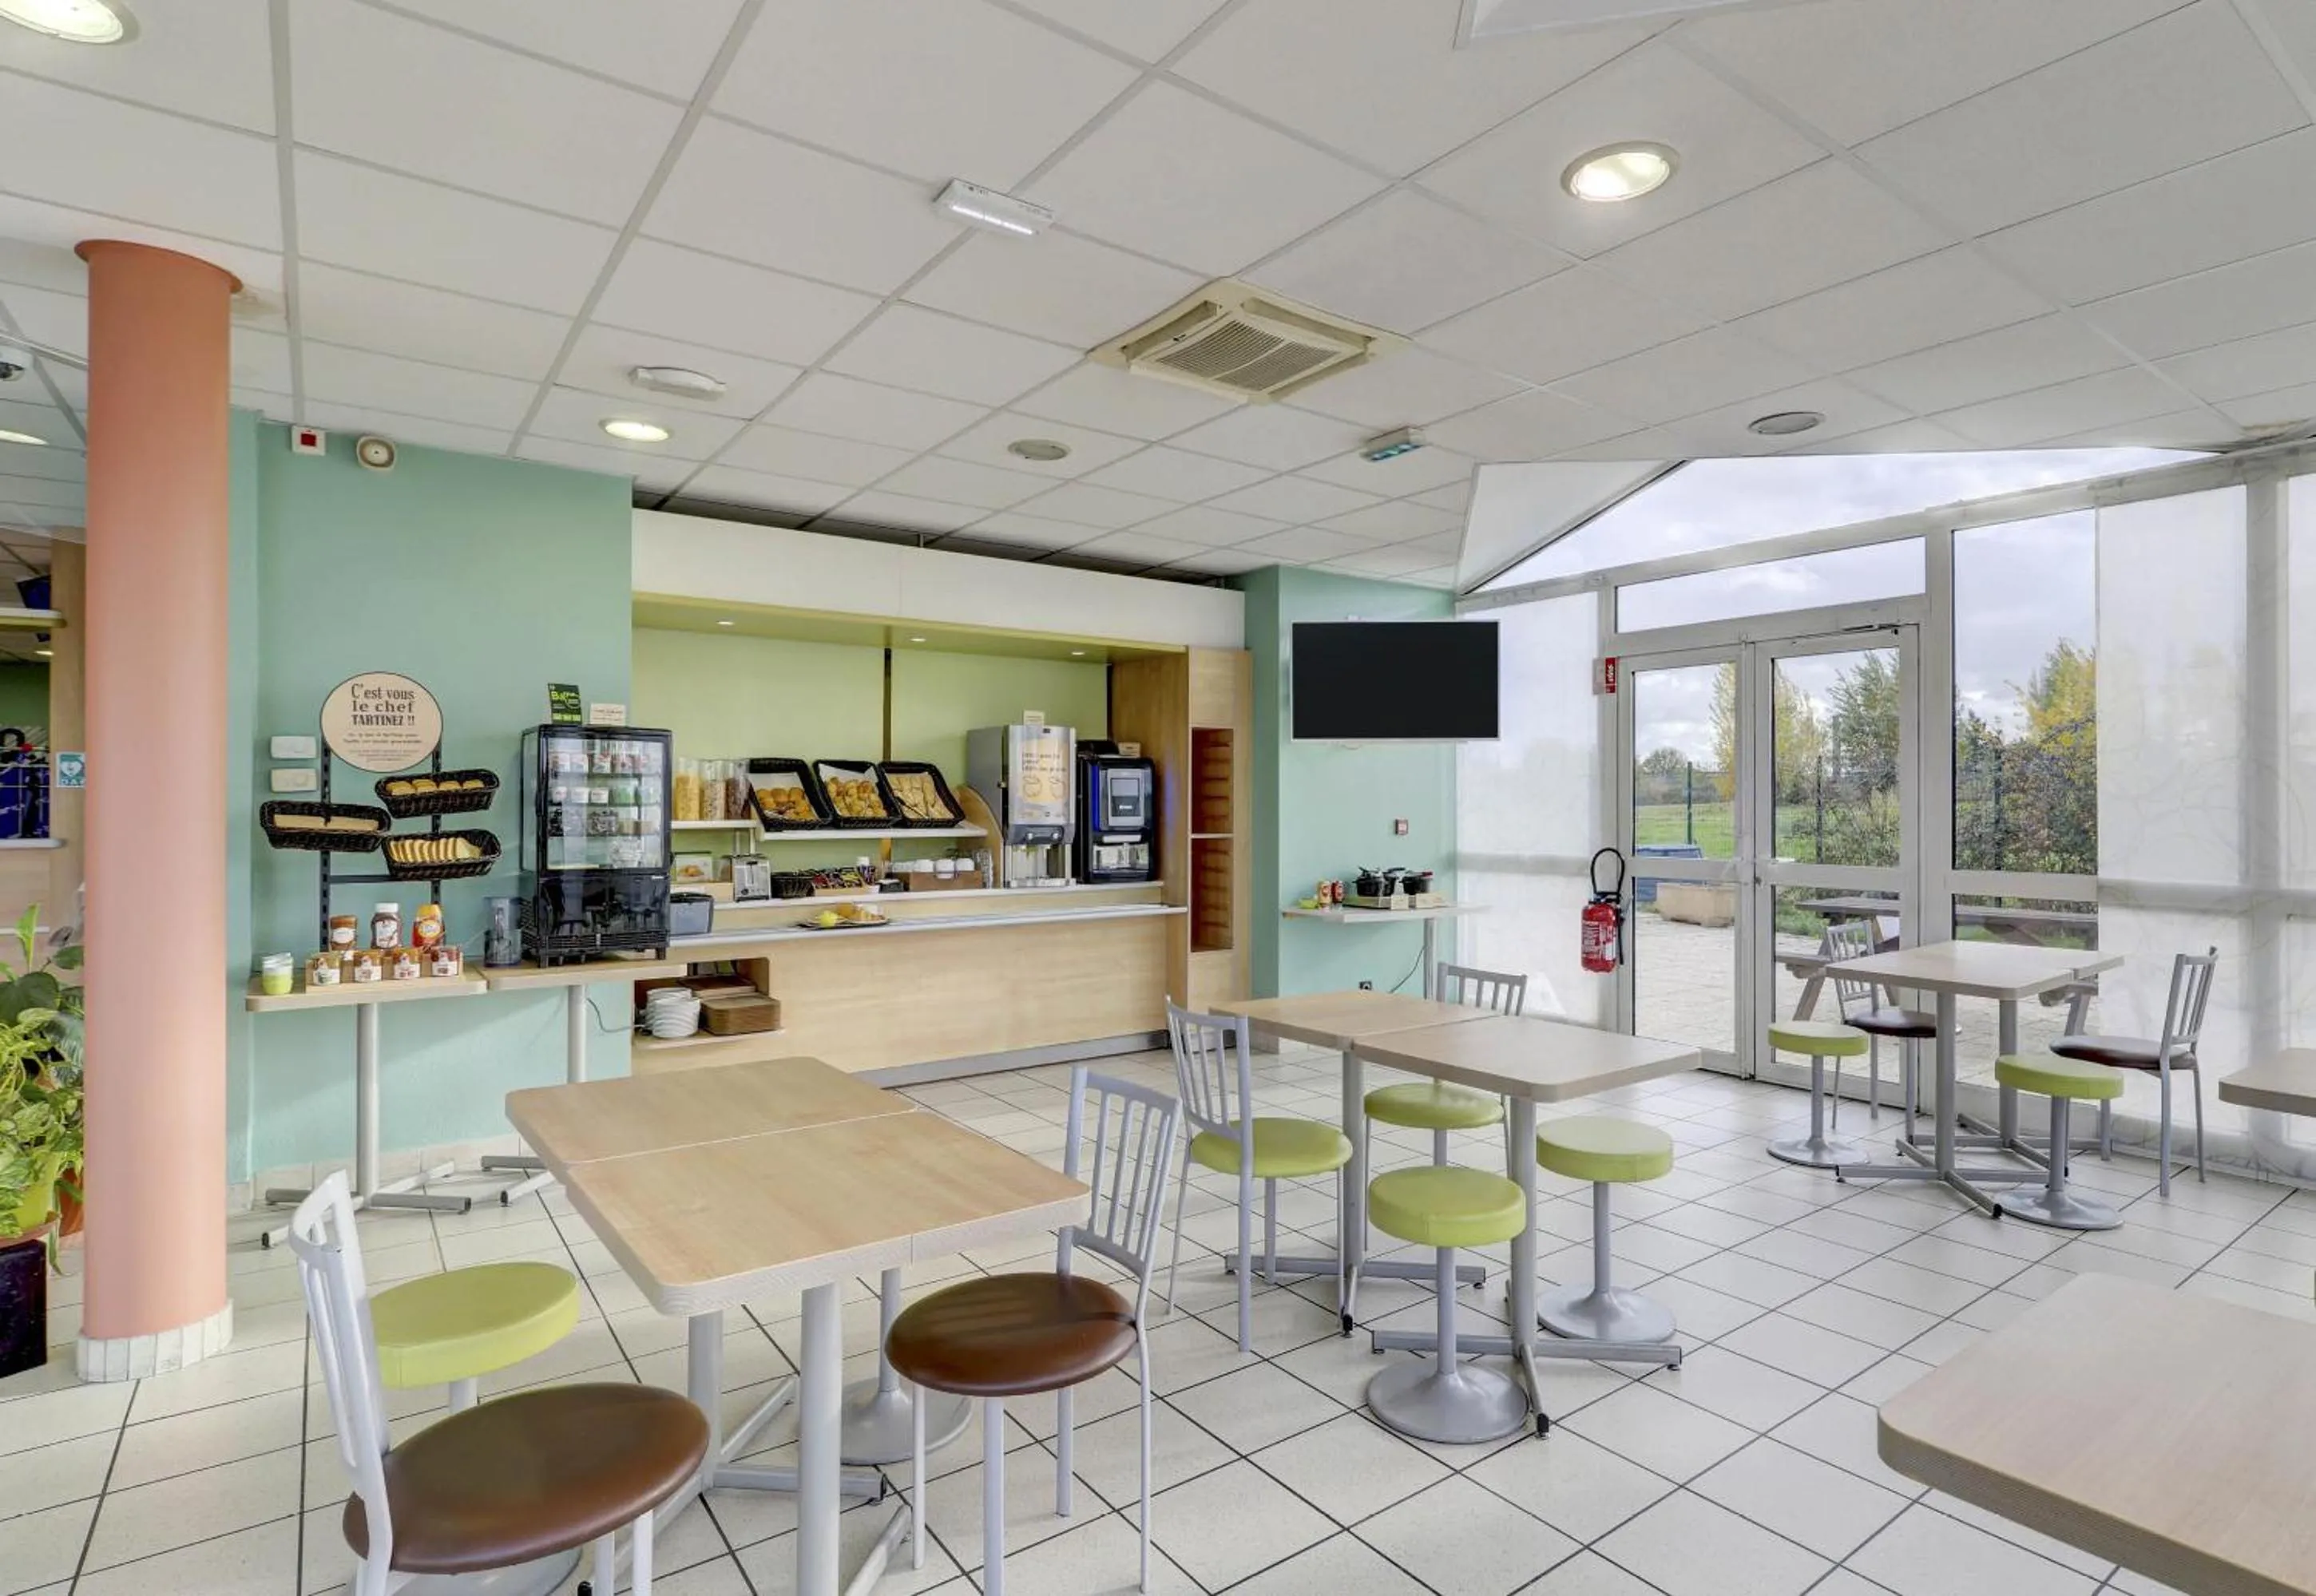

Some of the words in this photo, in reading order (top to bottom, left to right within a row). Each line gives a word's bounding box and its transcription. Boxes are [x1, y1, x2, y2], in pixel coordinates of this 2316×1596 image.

[351, 683, 382, 699] C'est
[387, 689, 415, 699] vous
[351, 700, 369, 712] le
[375, 700, 415, 713] chef
[351, 715, 404, 726] TARTINEZ
